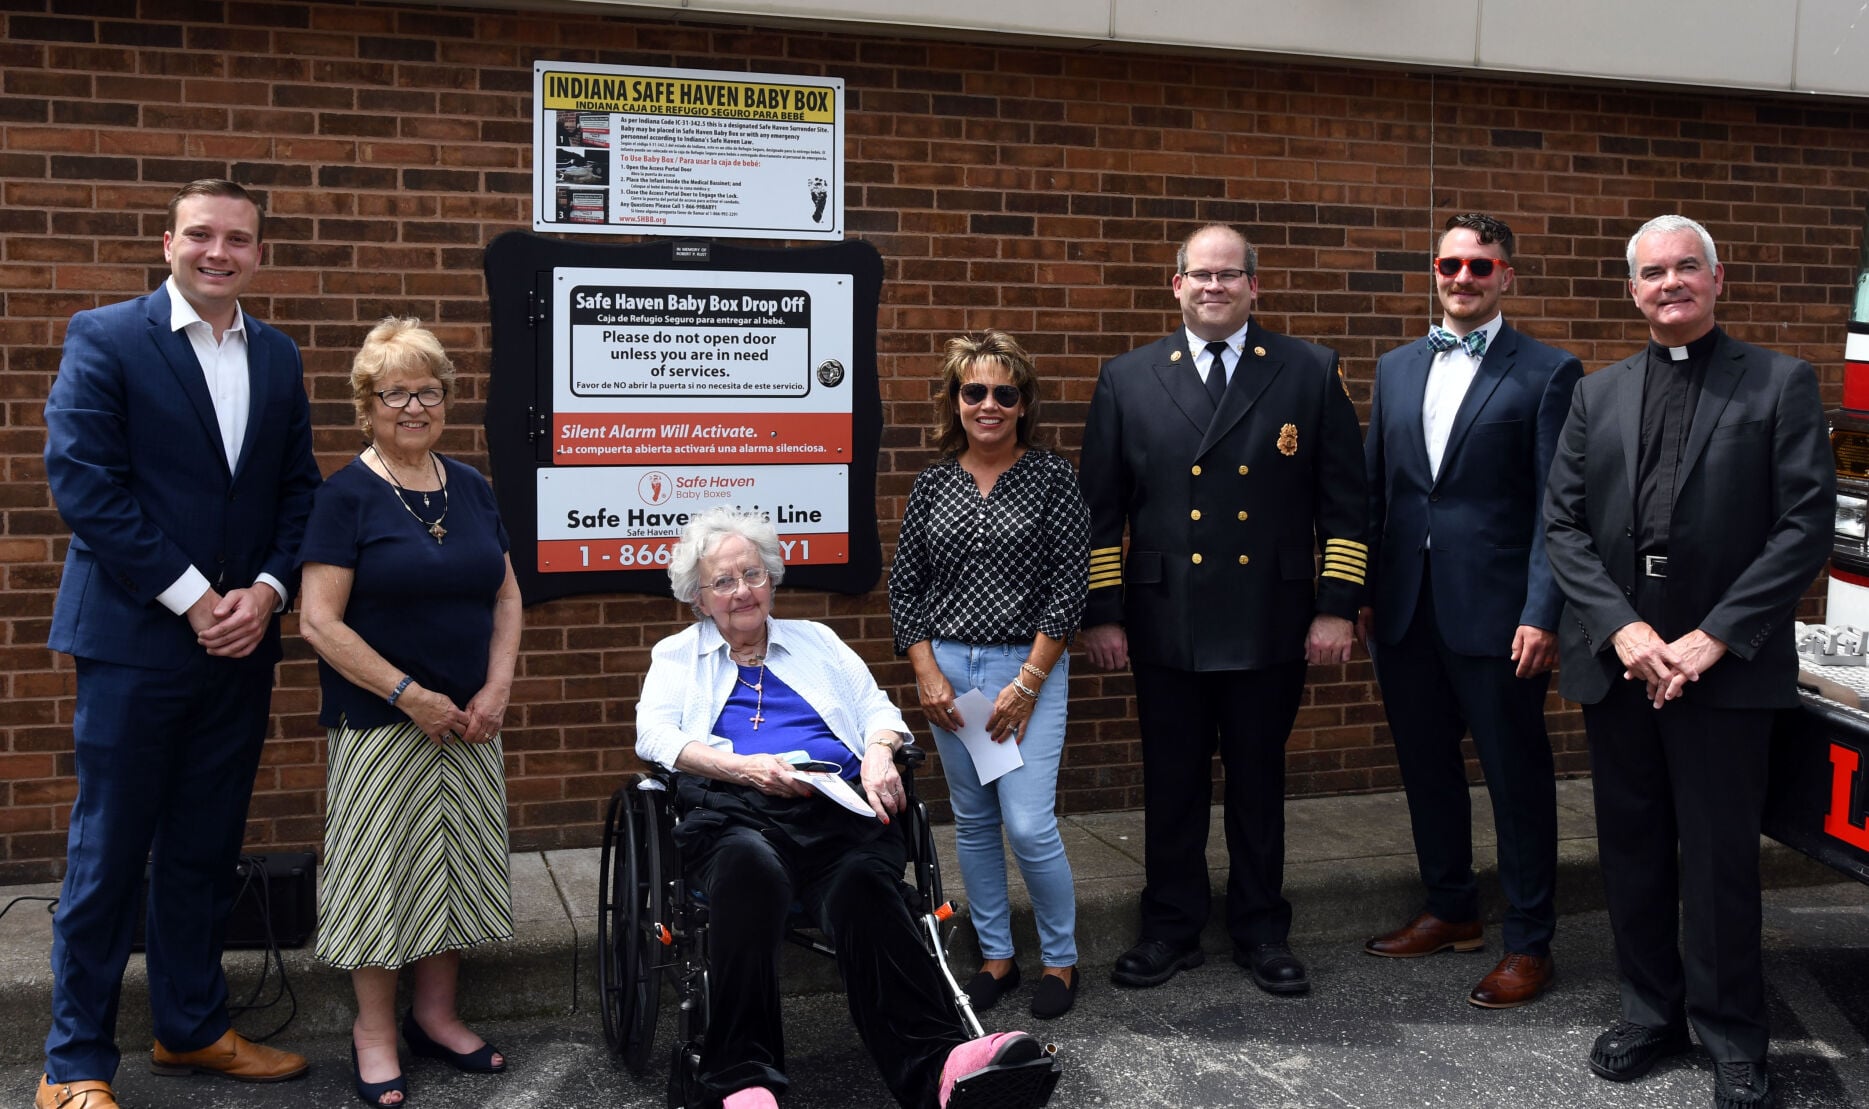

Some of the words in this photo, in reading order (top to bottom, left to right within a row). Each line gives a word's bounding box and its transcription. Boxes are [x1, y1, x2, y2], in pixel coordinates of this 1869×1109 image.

[550, 78, 628, 100] INDIANA
[632, 81, 674, 103] SAFE
[680, 84, 738, 106] HAVEN
[744, 88, 790, 109] BABY
[794, 90, 828, 112] BOX
[575, 101, 620, 112] INDIANA
[622, 103, 648, 114] CAJA
[650, 105, 664, 114] DE
[665, 106, 709, 116] REFUGIO
[711, 106, 751, 118] SEGURO
[753, 108, 778, 119] PARA
[781, 109, 804, 120] BEBÉ
[560, 135, 564, 144] 1
[643, 155, 660, 164] Baby
[718, 159, 732, 167] caja
[619, 215, 667, 224] www.SHBB.org
[576, 292, 611, 309] Safe
[616, 294, 664, 310] Haven
[668, 294, 706, 314] Baby
[710, 296, 738, 311] Box
[742, 296, 778, 318] Drop
[781, 297, 805, 312] Off
[597, 314, 616, 324] Caja
[630, 315, 663, 324] Refugio
[665, 315, 695, 325] Seguro
[716, 317, 752, 326] entregar
[603, 331, 649, 343] Please
[653, 331, 672, 343] do
[676, 333, 700, 344] not
[704, 335, 739, 347] open
[743, 332, 776, 344] door
[611, 348, 656, 360] unless
[661, 351, 686, 363] you
[691, 352, 713, 360] are
[717, 349, 730, 360] in
[734, 349, 768, 361] need
[651, 364, 666, 376] of
[669, 365, 730, 377] services.
[561, 424, 606, 438] Silent
[609, 424, 656, 438] Alarm
[661, 424, 689, 438] Will
[692, 425, 757, 438] Activate.
[560, 445, 573, 454] La
[575, 446, 632, 456] compuerta
[635, 444, 672, 454] abierta
[674, 444, 715, 453] activará
[739, 444, 774, 453] alarma
[776, 443, 826, 452] silenciosa.
[676, 476, 707, 488] Safe
[710, 476, 755, 487] Haven
[676, 490, 700, 500] Baby
[704, 490, 731, 498] Boxes
[568, 508, 620, 528] Safe
[778, 504, 822, 524] Line
[647, 528, 674, 536] Haven
[580, 546, 589, 567] 1
